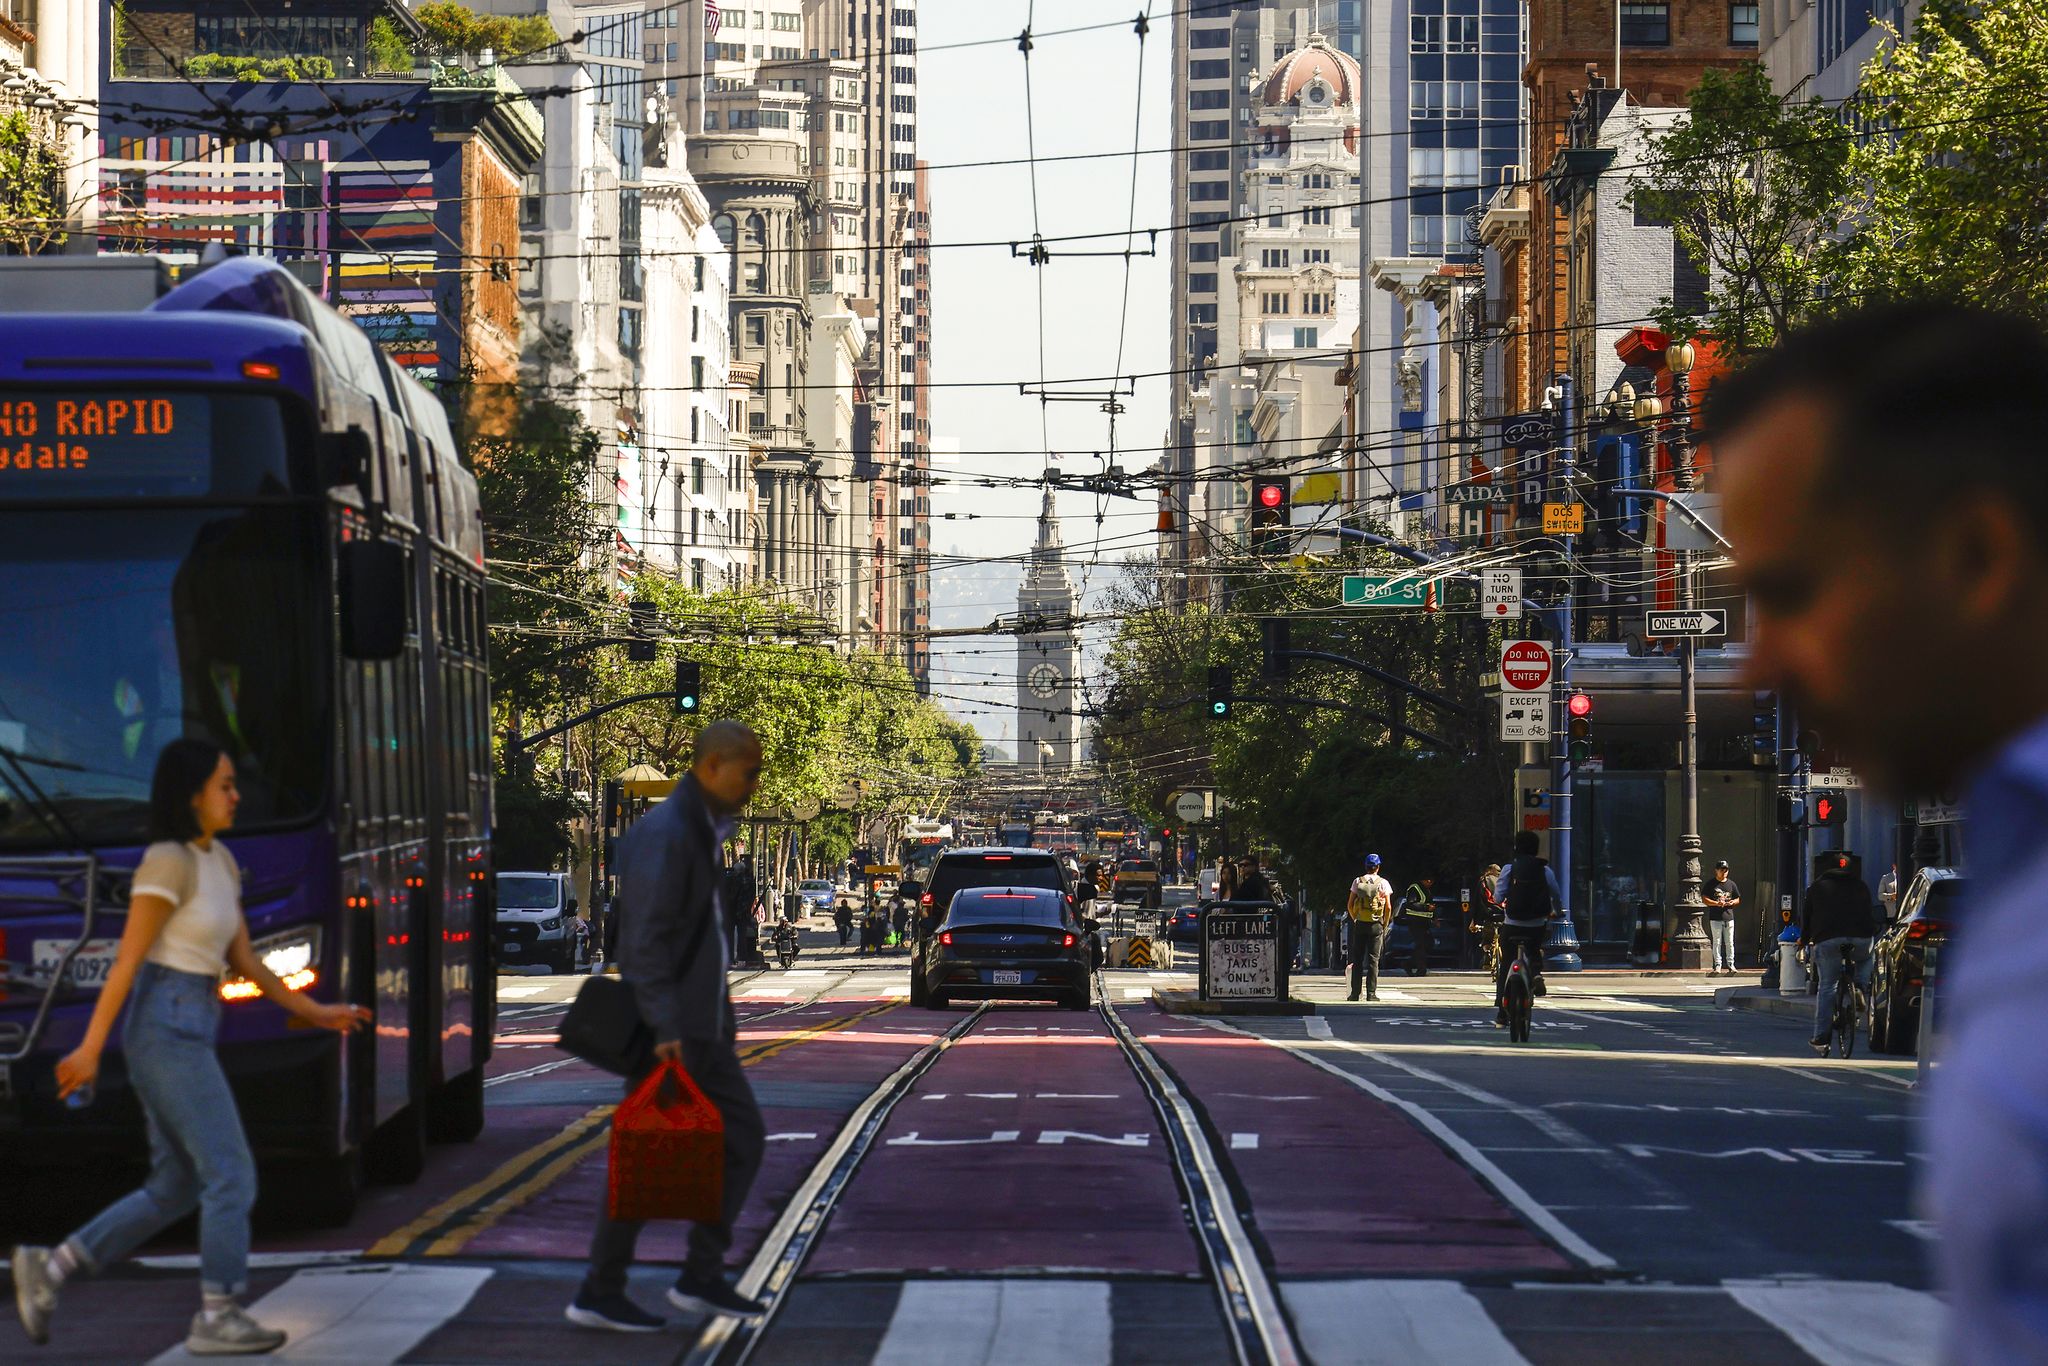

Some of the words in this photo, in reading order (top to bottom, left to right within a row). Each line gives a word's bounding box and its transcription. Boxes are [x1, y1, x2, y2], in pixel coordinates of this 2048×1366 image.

[56, 400, 173, 435] RAPID
[1450, 486, 1508, 503] AIDA
[1553, 508, 1573, 517] OCS
[1546, 520, 1579, 529] SWITCH
[1493, 574, 1510, 583] NO
[1364, 584, 1392, 598] 8th
[1403, 585, 1422, 599] St
[1490, 585, 1513, 593] TURN
[1485, 595, 1499, 603] ON
[1502, 595, 1518, 603] RED
[1654, 618, 1676, 629] ONE
[1679, 617, 1703, 629] WAY
[1509, 651, 1521, 659] DO
[1527, 651, 1544, 659] NOT
[1512, 672, 1540, 681] ENTER
[1509, 698, 1542, 706] EXCEPT
[1823, 777, 1839, 785] 8th
[1212, 921, 1236, 935] LEFT
[1245, 921, 1271, 935] LANE
[1224, 944, 1260, 954] BUSES
[1227, 959, 1258, 969] TAXIS
[1228, 973, 1256, 983] ONLY
[1213, 986, 1223, 995] AT
[1228, 986, 1241, 995] ALL
[1249, 986, 1272, 995] TIMES
